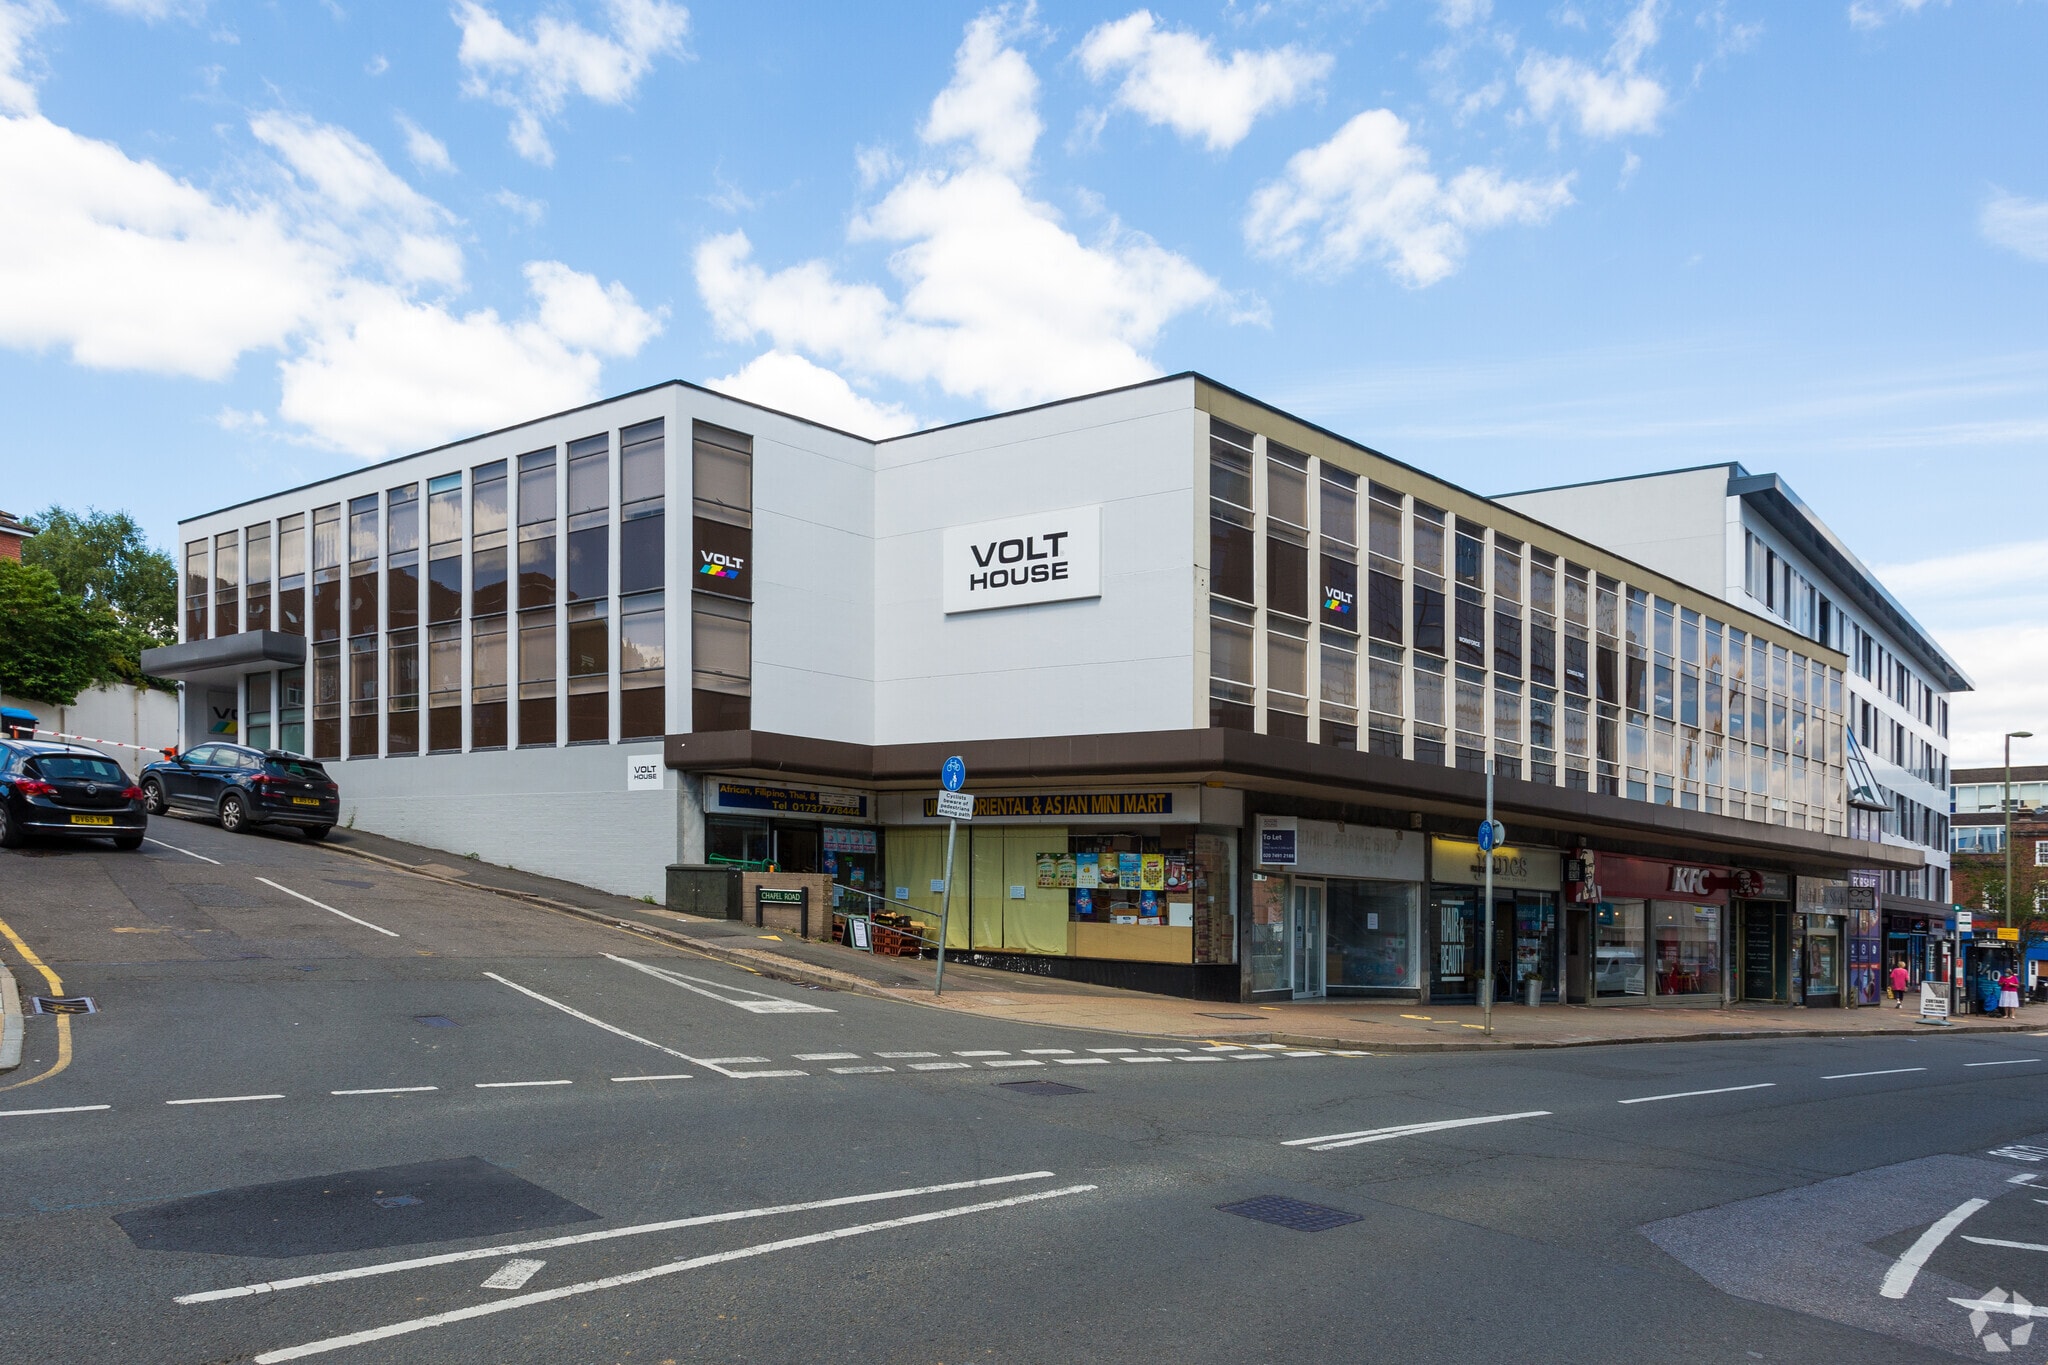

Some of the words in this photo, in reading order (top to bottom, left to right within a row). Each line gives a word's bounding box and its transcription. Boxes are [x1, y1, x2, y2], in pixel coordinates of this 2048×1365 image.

[970, 531, 1068, 567] VOLT
[700, 550, 744, 569] VOLT
[970, 561, 1068, 591] HOUSE
[1324, 586, 1353, 603] VOLT
[634, 765, 657, 774] VOLT
[720, 785, 753, 798] African,
[790, 790, 810, 800] Thai,
[772, 801, 788, 810] Tel
[792, 803, 824, 813] 01737
[826, 805, 860, 816] 778444
[940, 804, 970, 812] pedestrians
[1032, 797, 1041, 814] &
[1092, 794, 1120, 814] MINI
[1124, 794, 1166, 813] MART
[1672, 866, 1710, 895] KFC
[761, 892, 783, 900] CHAPEL
[784, 892, 800, 900] ROAD
[1441, 907, 1459, 942] HAIR
[1460, 916, 1464, 942] &
[1441, 944, 1465, 974] BEAUTY
